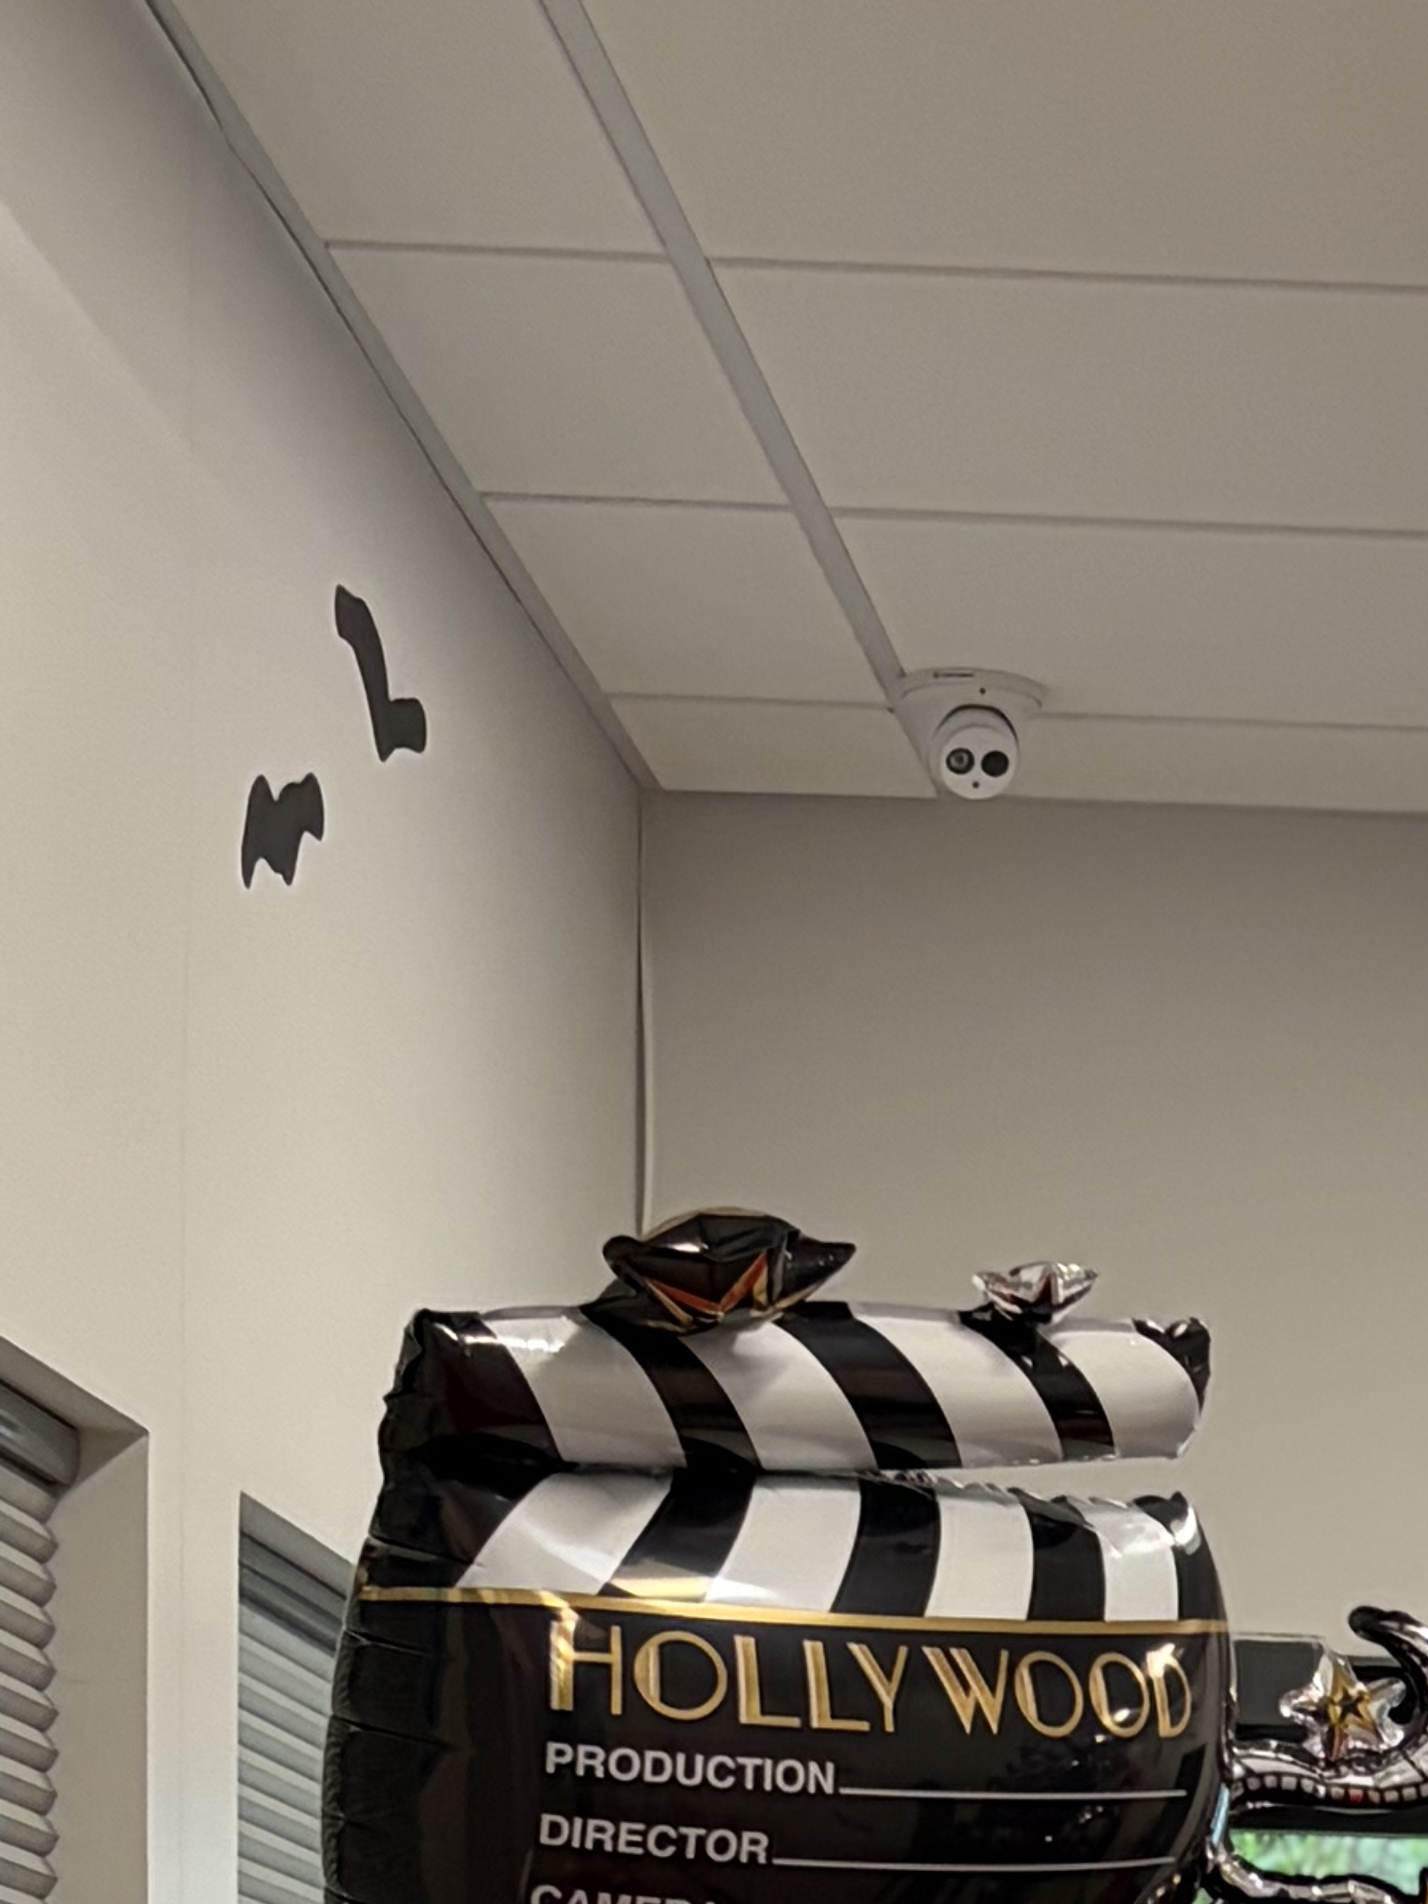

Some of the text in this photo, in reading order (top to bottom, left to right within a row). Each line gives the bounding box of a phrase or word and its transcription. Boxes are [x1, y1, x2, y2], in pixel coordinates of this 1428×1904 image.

[549, 1618, 1192, 1738] HOLLYWOOD
[545, 1741, 835, 1795] PRODUCTION
[538, 1813, 769, 1865] DIRECTOR
